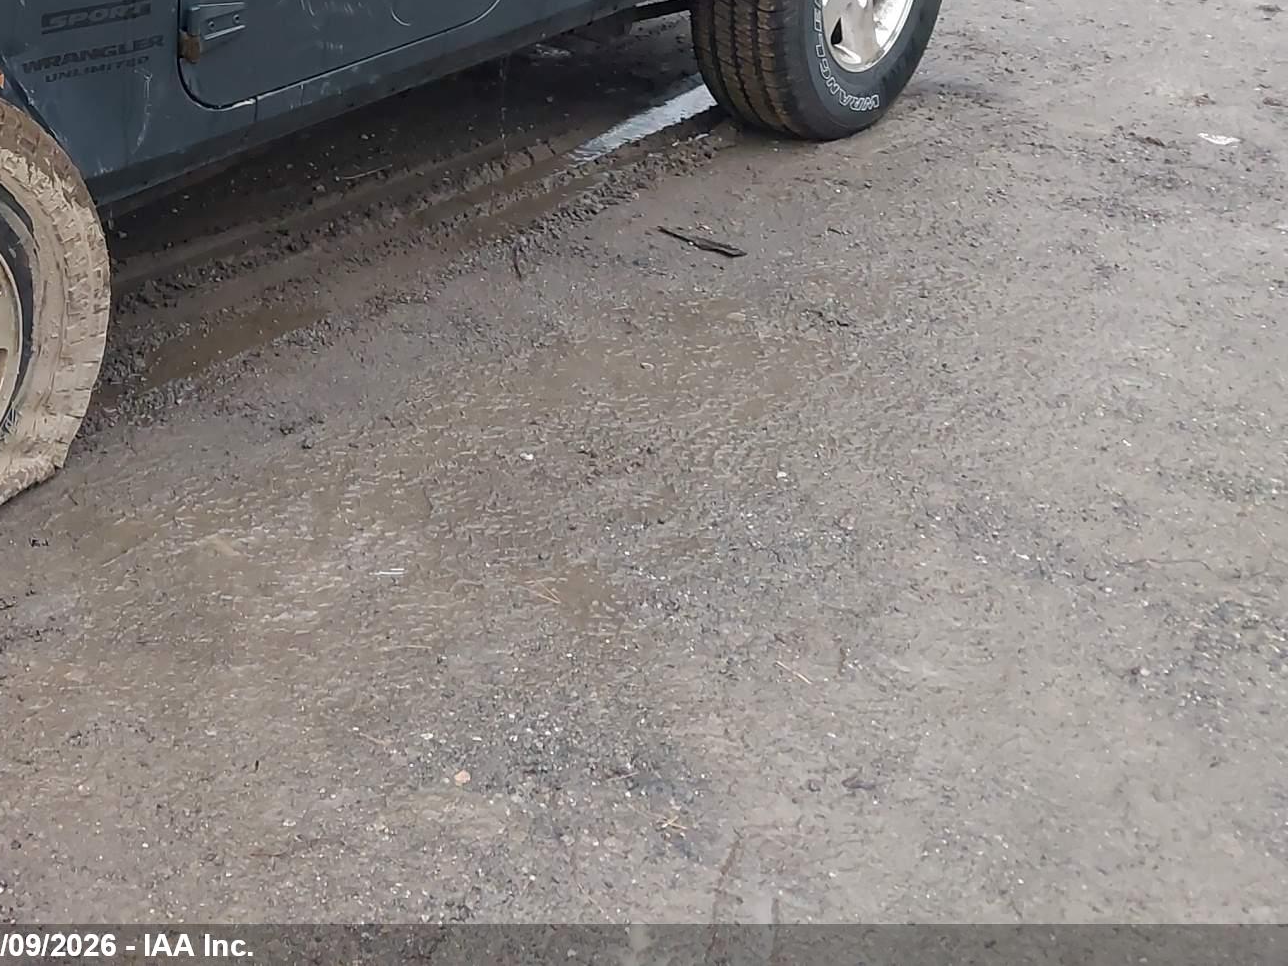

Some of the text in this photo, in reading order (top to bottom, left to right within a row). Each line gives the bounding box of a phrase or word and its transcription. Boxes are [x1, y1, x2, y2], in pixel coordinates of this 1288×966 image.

[47, 0, 146, 30] SPORT
[22, 34, 165, 74] WRANGLER
[44, 55, 150, 83] UNLIMITED
